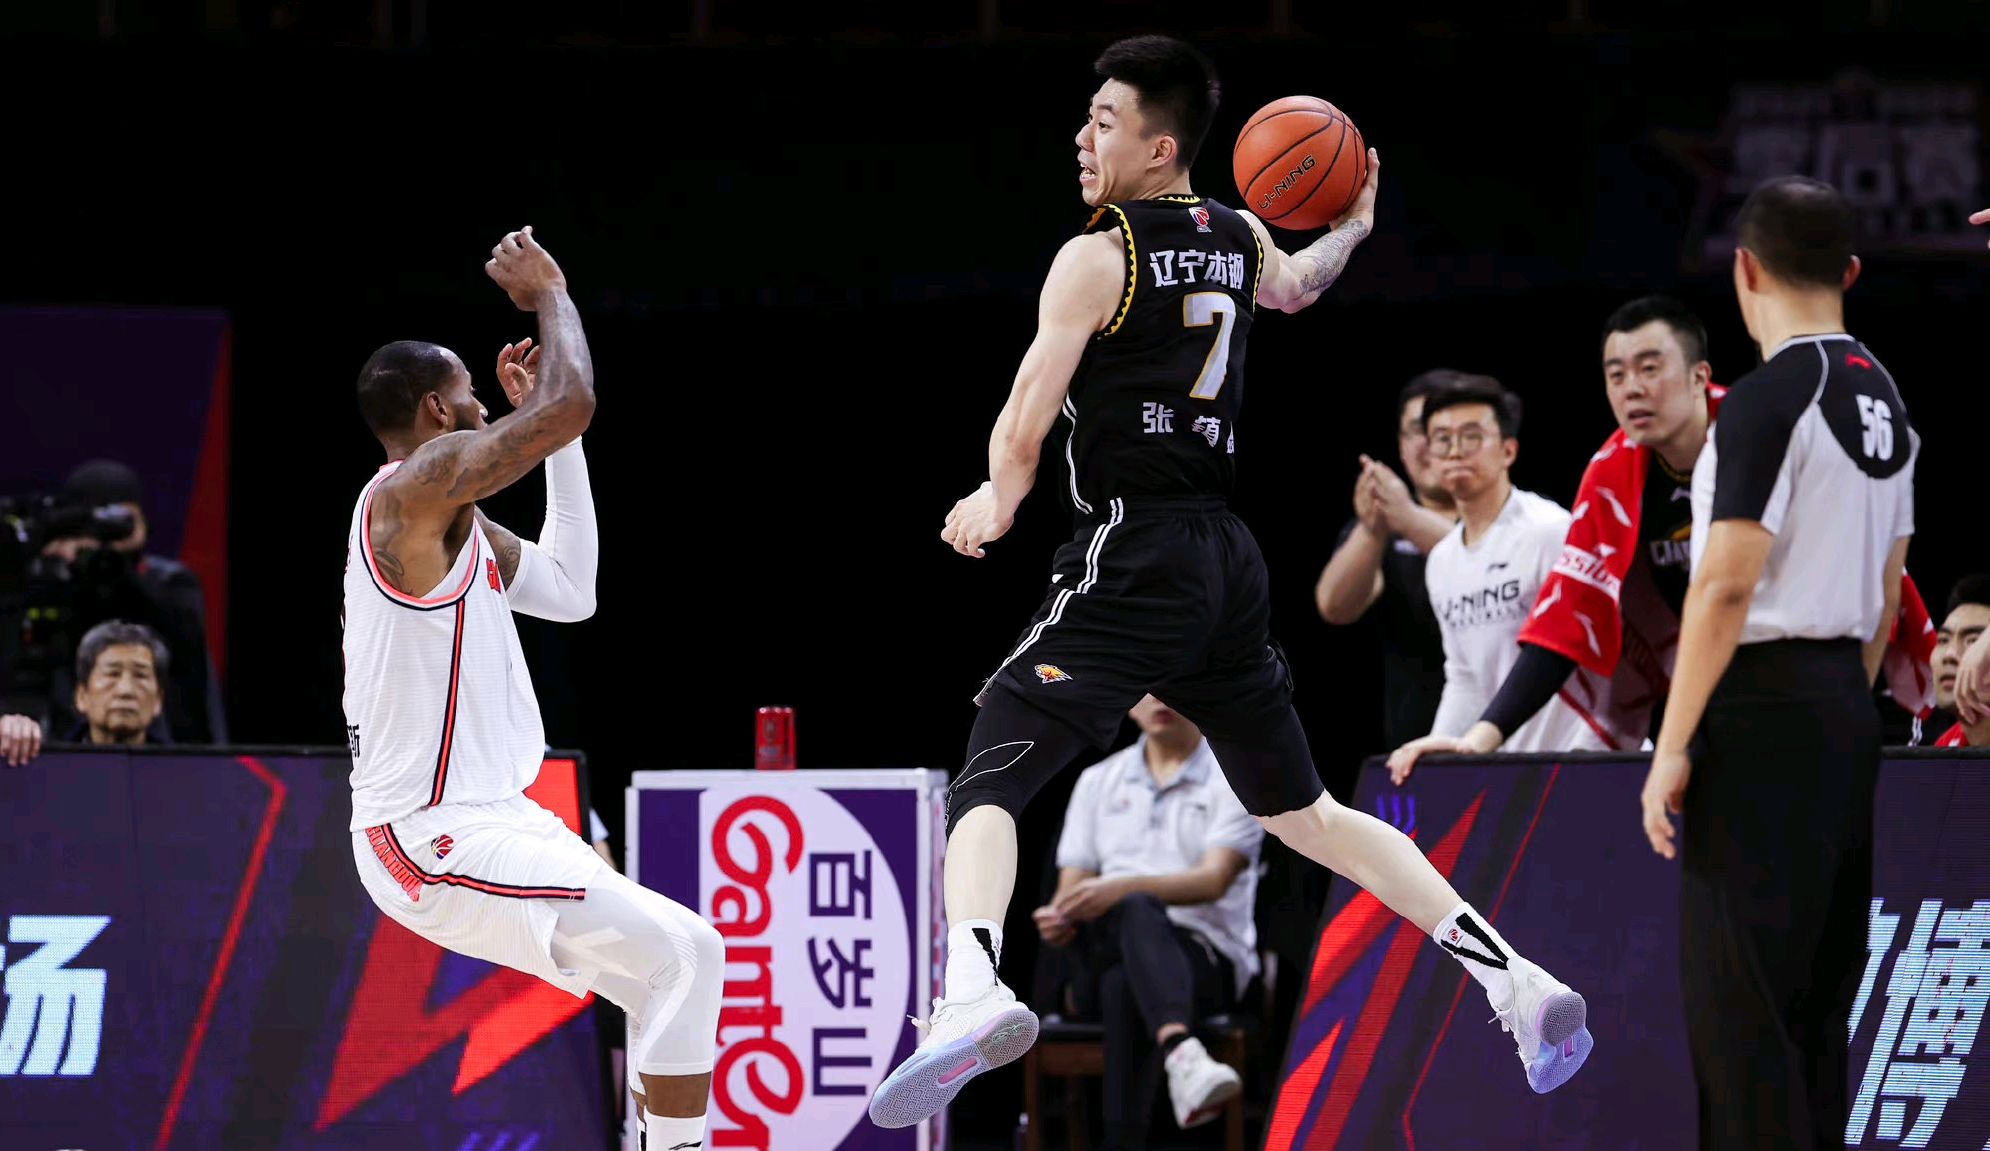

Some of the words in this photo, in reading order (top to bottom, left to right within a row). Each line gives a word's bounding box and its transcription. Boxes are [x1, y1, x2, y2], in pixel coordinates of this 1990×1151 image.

[1256, 154, 1316, 209] LI-NING
[1149, 249, 1244, 289] 辽宁本钢
[1183, 291, 1236, 400] 7
[1856, 394, 1894, 461] 56
[807, 849, 875, 1098] 百岁山
